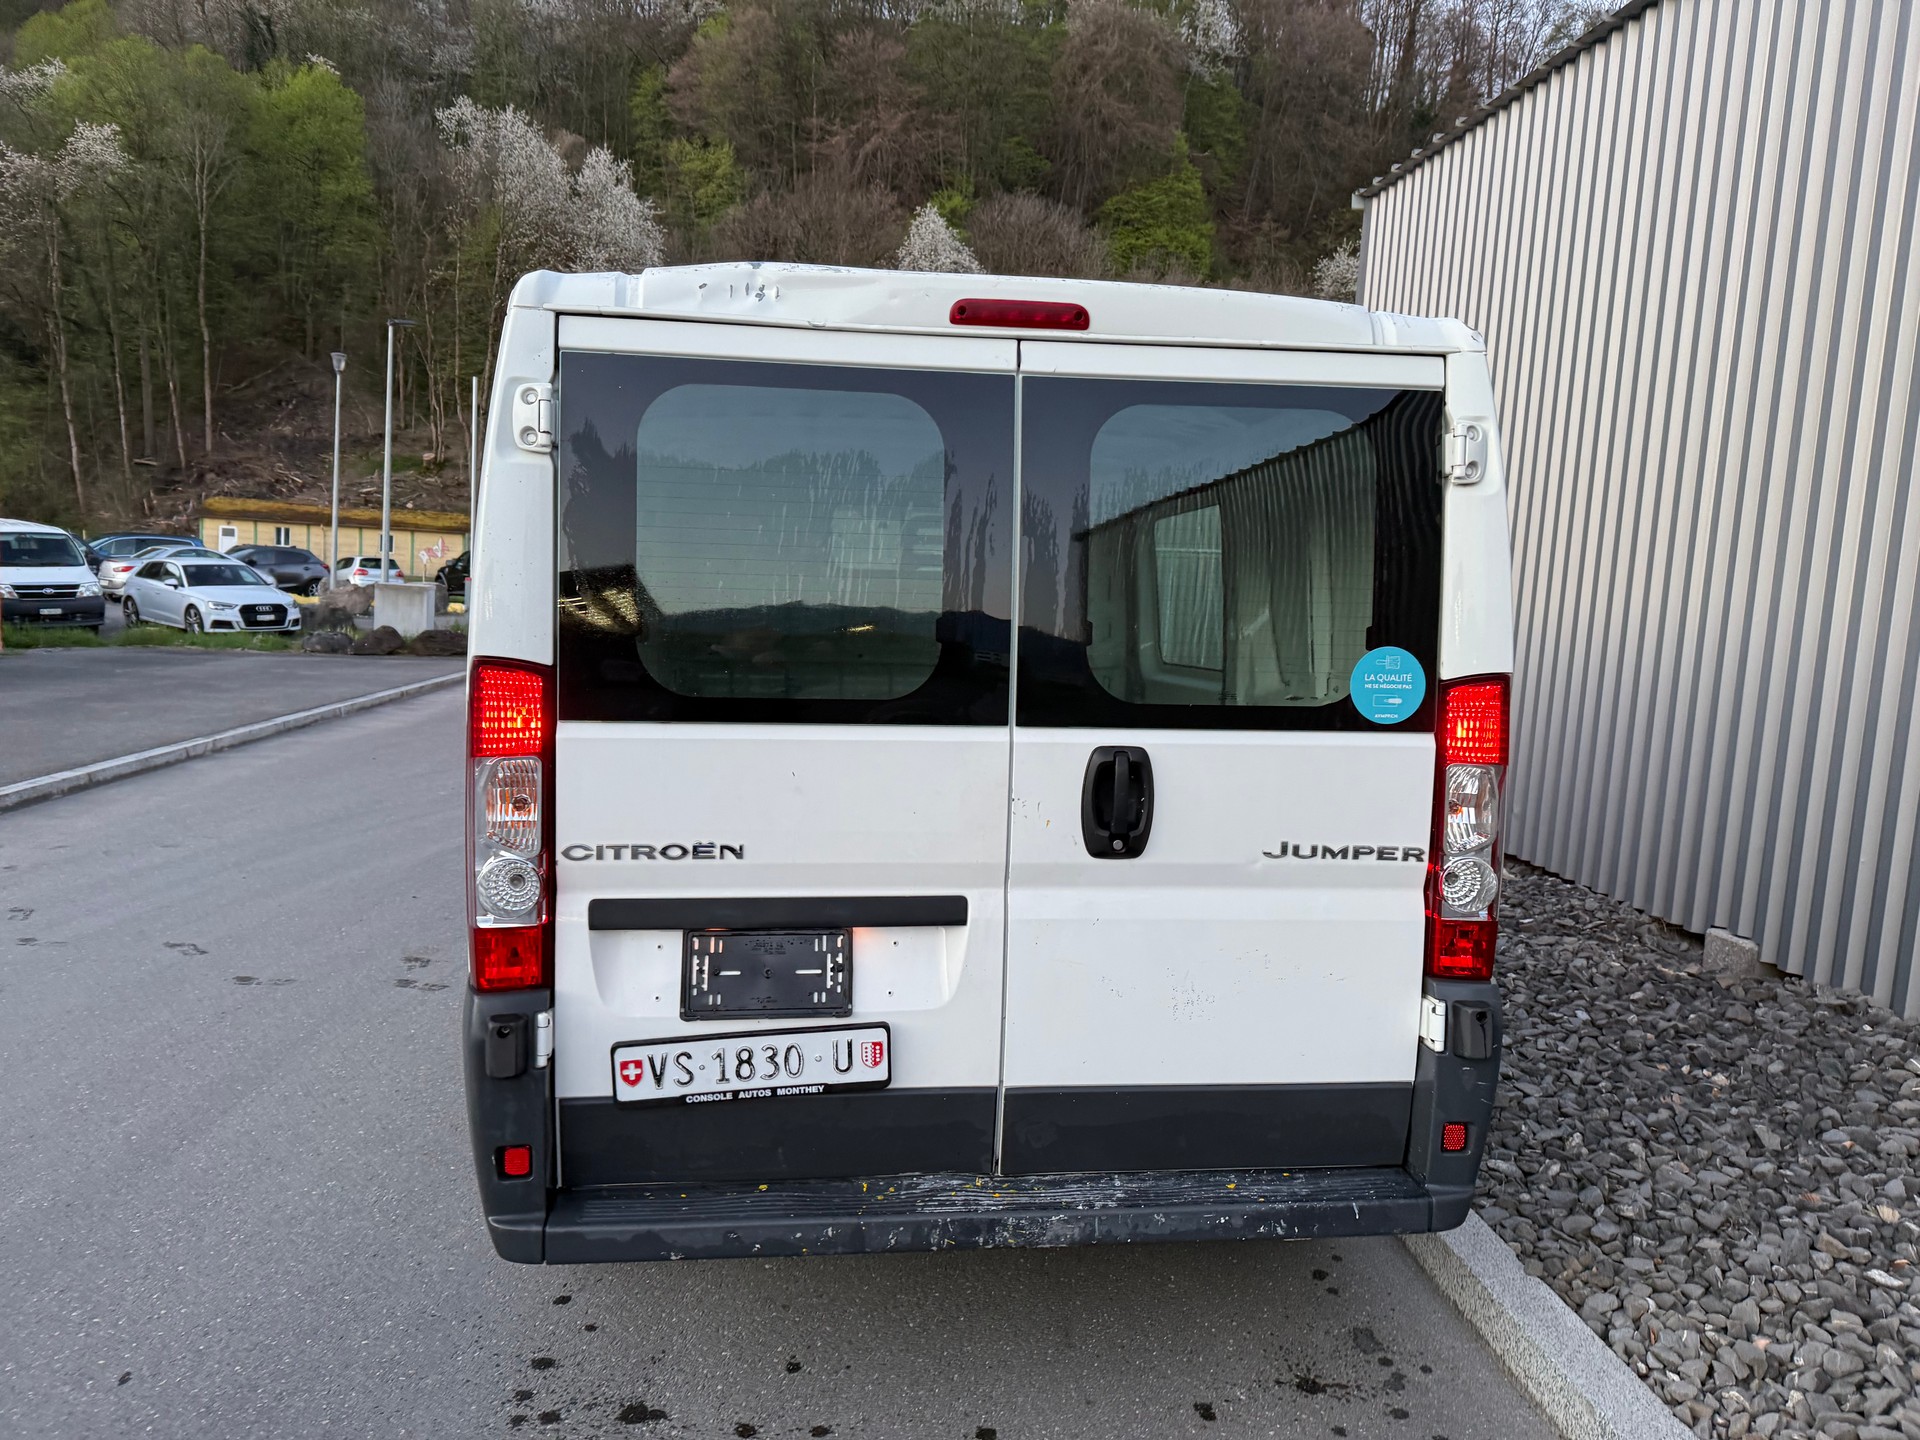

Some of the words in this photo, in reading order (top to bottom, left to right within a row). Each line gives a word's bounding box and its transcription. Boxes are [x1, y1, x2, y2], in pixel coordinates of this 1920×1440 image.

[1364, 673, 1375, 681] LA
[1376, 672, 1412, 682] QUALITÉ
[560, 840, 744, 862] CITROËN
[1262, 841, 1426, 862] JUMPER
[831, 1038, 854, 1075] U
[685, 1092, 733, 1104] CONSOLE
[738, 1089, 772, 1099] AUTOS
[777, 1085, 825, 1096] MONTHEY
